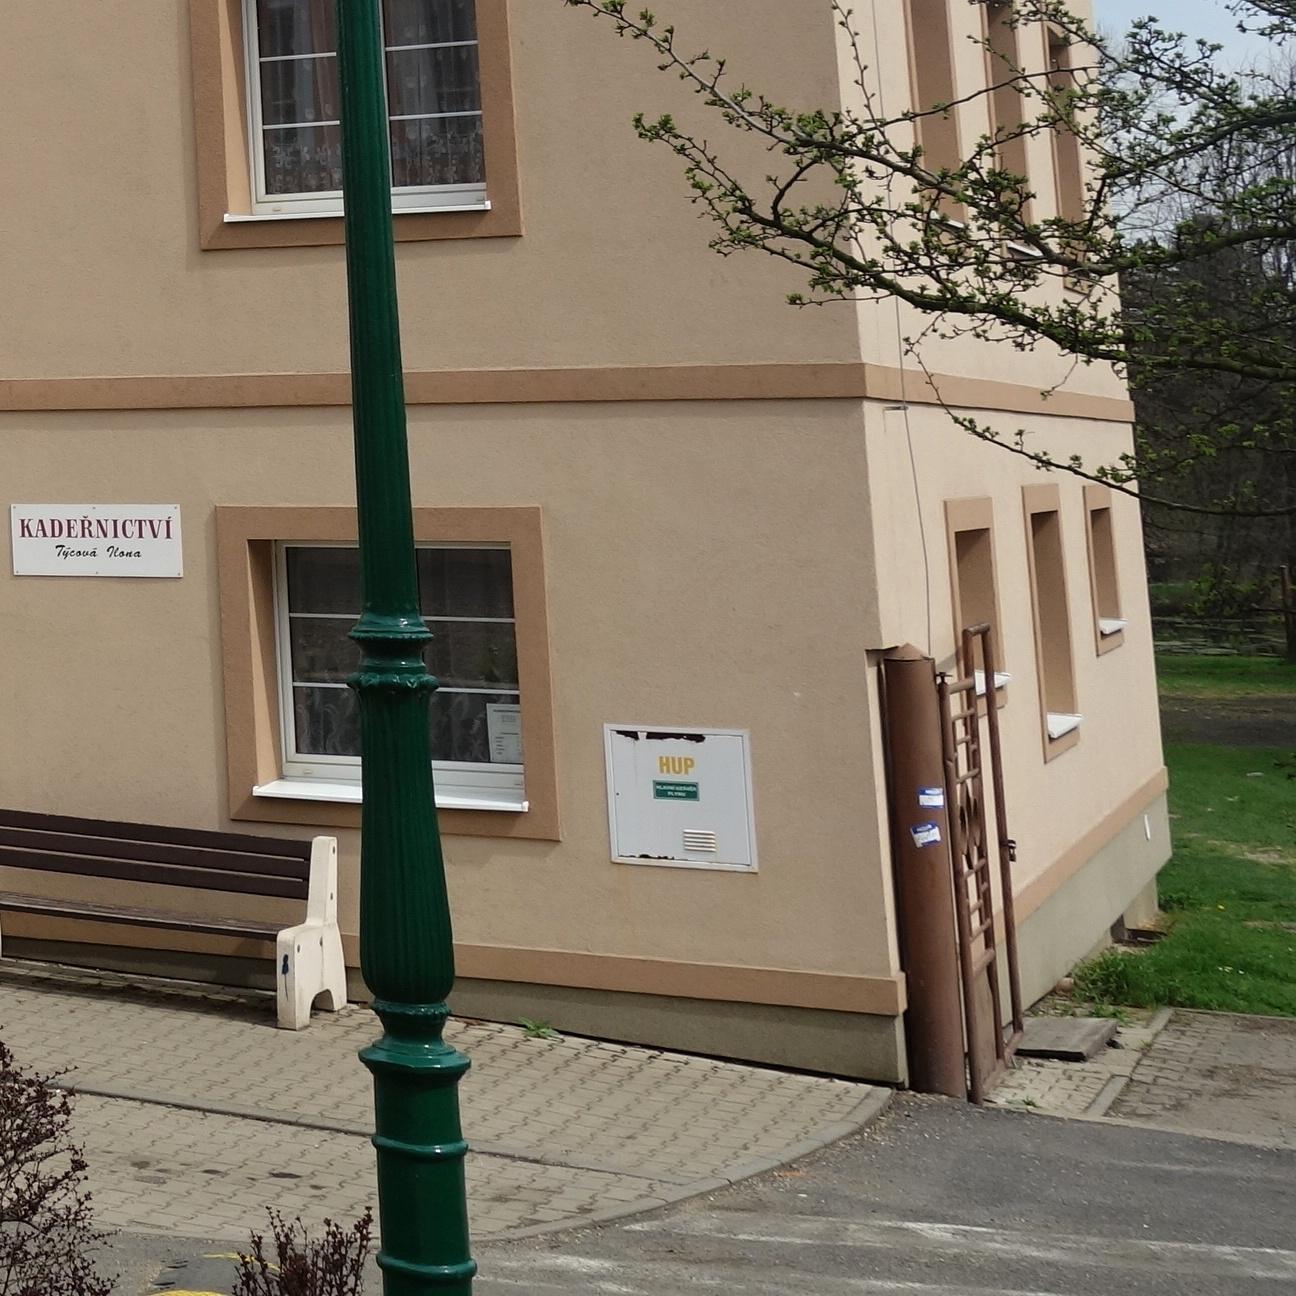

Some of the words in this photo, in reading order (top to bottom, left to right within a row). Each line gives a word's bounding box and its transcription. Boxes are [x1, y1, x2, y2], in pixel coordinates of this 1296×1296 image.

[19, 515, 173, 540] KADEŘNICTVÍ
[55, 544, 98, 560] Týcová
[106, 545, 142, 559] Ilona
[658, 756, 695, 775] HUP
